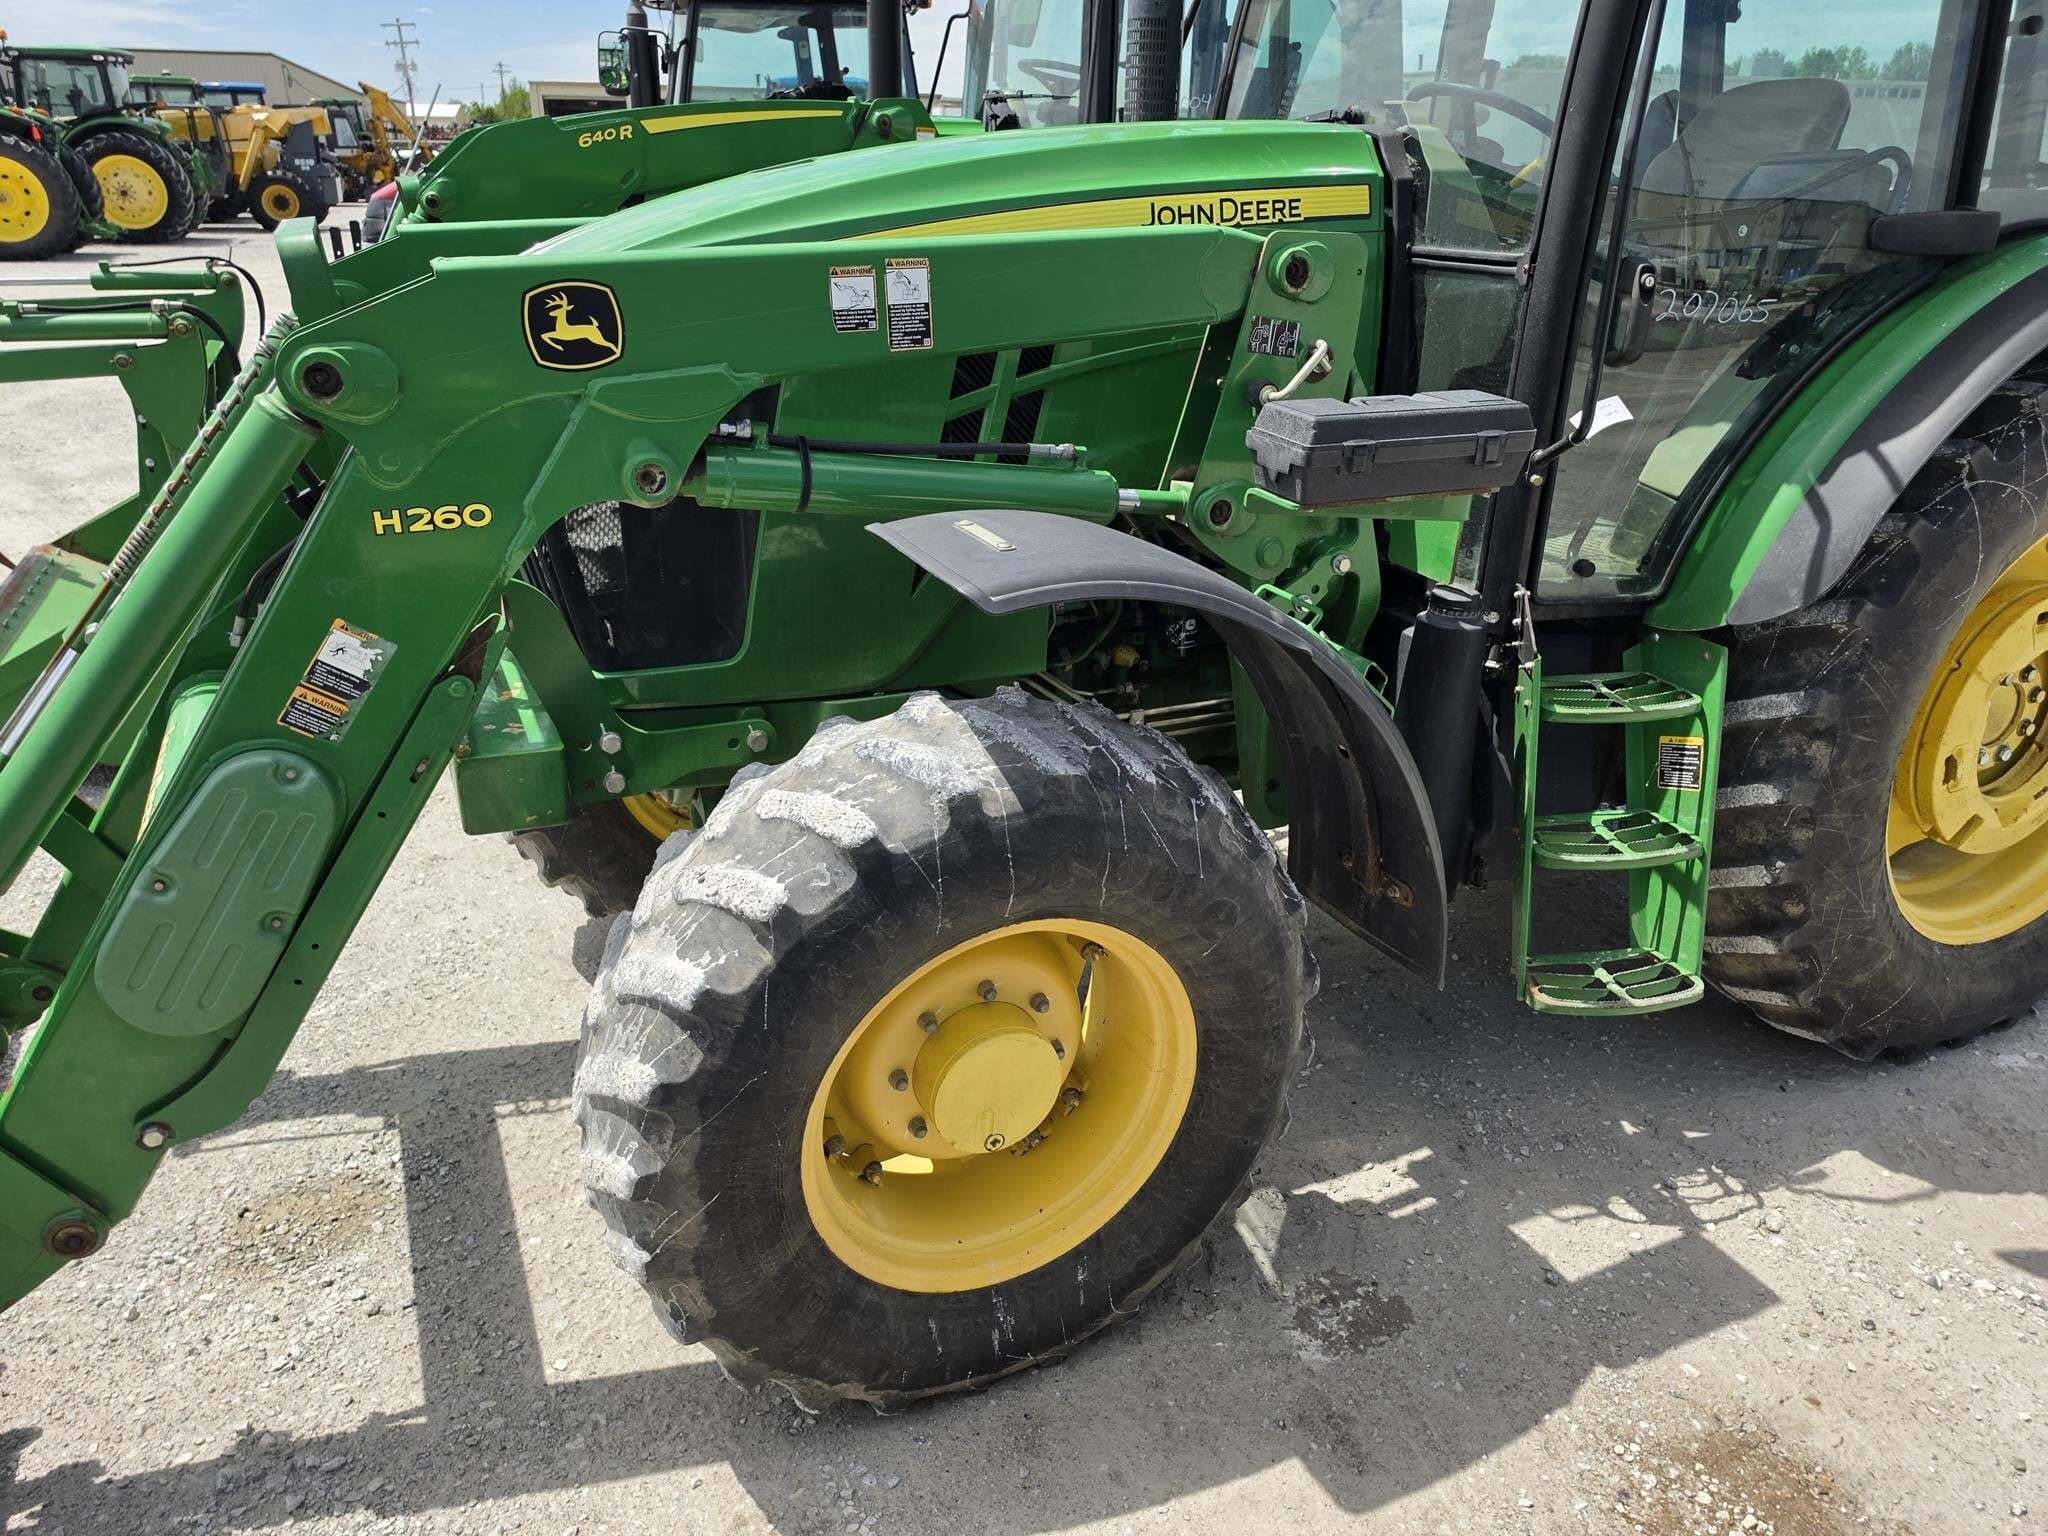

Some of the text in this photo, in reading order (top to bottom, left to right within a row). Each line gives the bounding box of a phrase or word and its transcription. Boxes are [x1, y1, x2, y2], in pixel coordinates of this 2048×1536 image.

[1141, 198, 1302, 226] JOHN DEERE
[839, 267, 873, 275] WARNING
[894, 259, 927, 267] WARNING
[1655, 288, 1778, 325] 207065
[372, 502, 493, 535] H260
[311, 697, 346, 714] WARNIN
